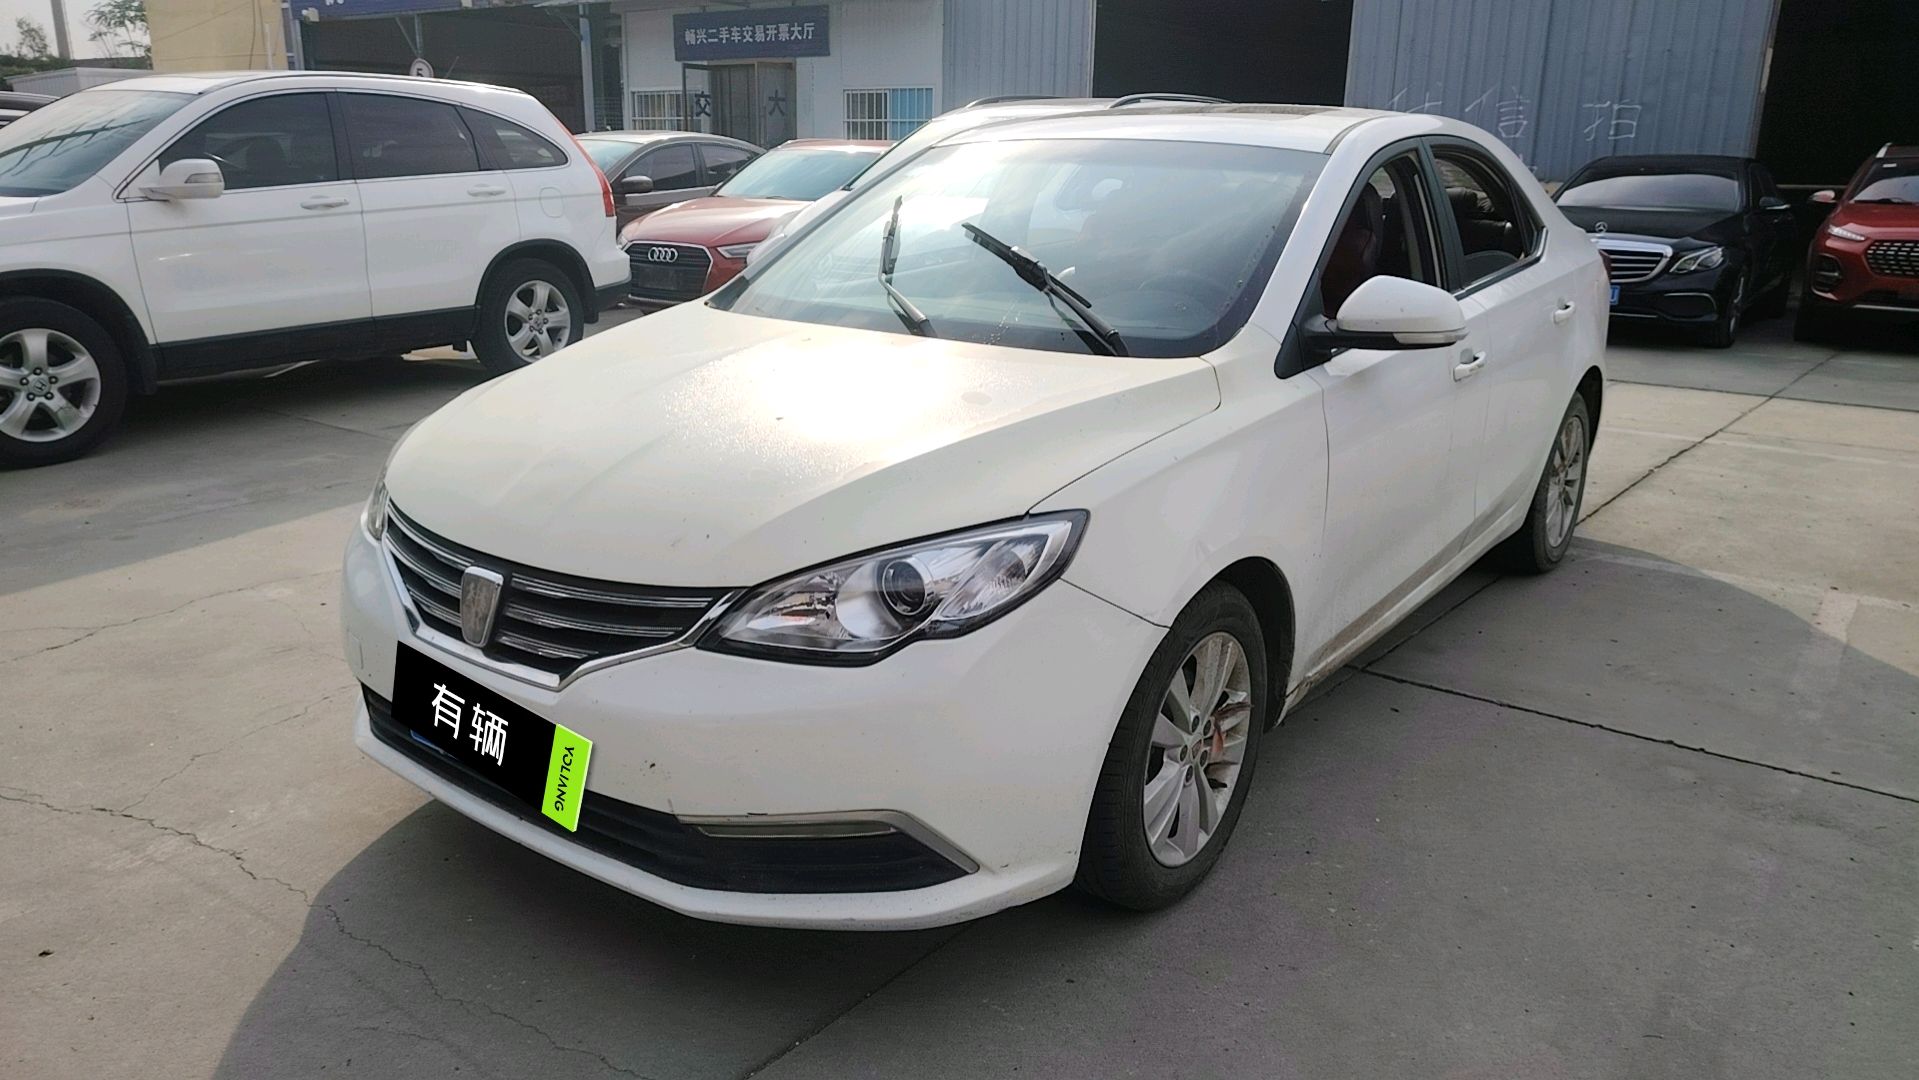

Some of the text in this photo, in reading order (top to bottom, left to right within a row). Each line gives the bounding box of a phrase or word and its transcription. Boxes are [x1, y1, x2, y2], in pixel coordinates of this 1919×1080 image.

[685, 23, 815, 45] 畅兴二手车交易开票大厅
[694, 91, 786, 117] 交 大
